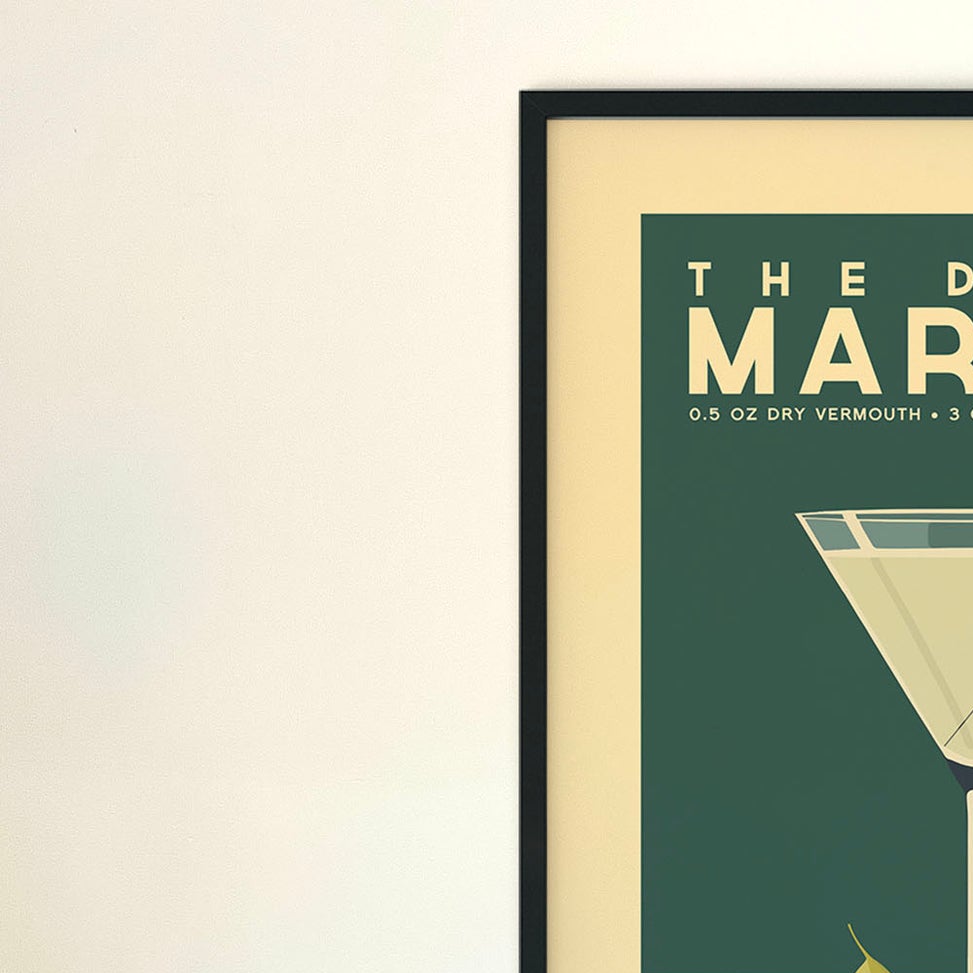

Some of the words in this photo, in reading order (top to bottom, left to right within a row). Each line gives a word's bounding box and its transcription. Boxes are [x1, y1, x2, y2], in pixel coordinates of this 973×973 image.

[688, 261, 865, 297] THE
[689, 407, 720, 421] 0.5
[730, 407, 758, 421] OZ
[767, 407, 806, 421] DRY
[815, 407, 921, 421] VERMOUTH
[949, 407, 960, 421] 3
